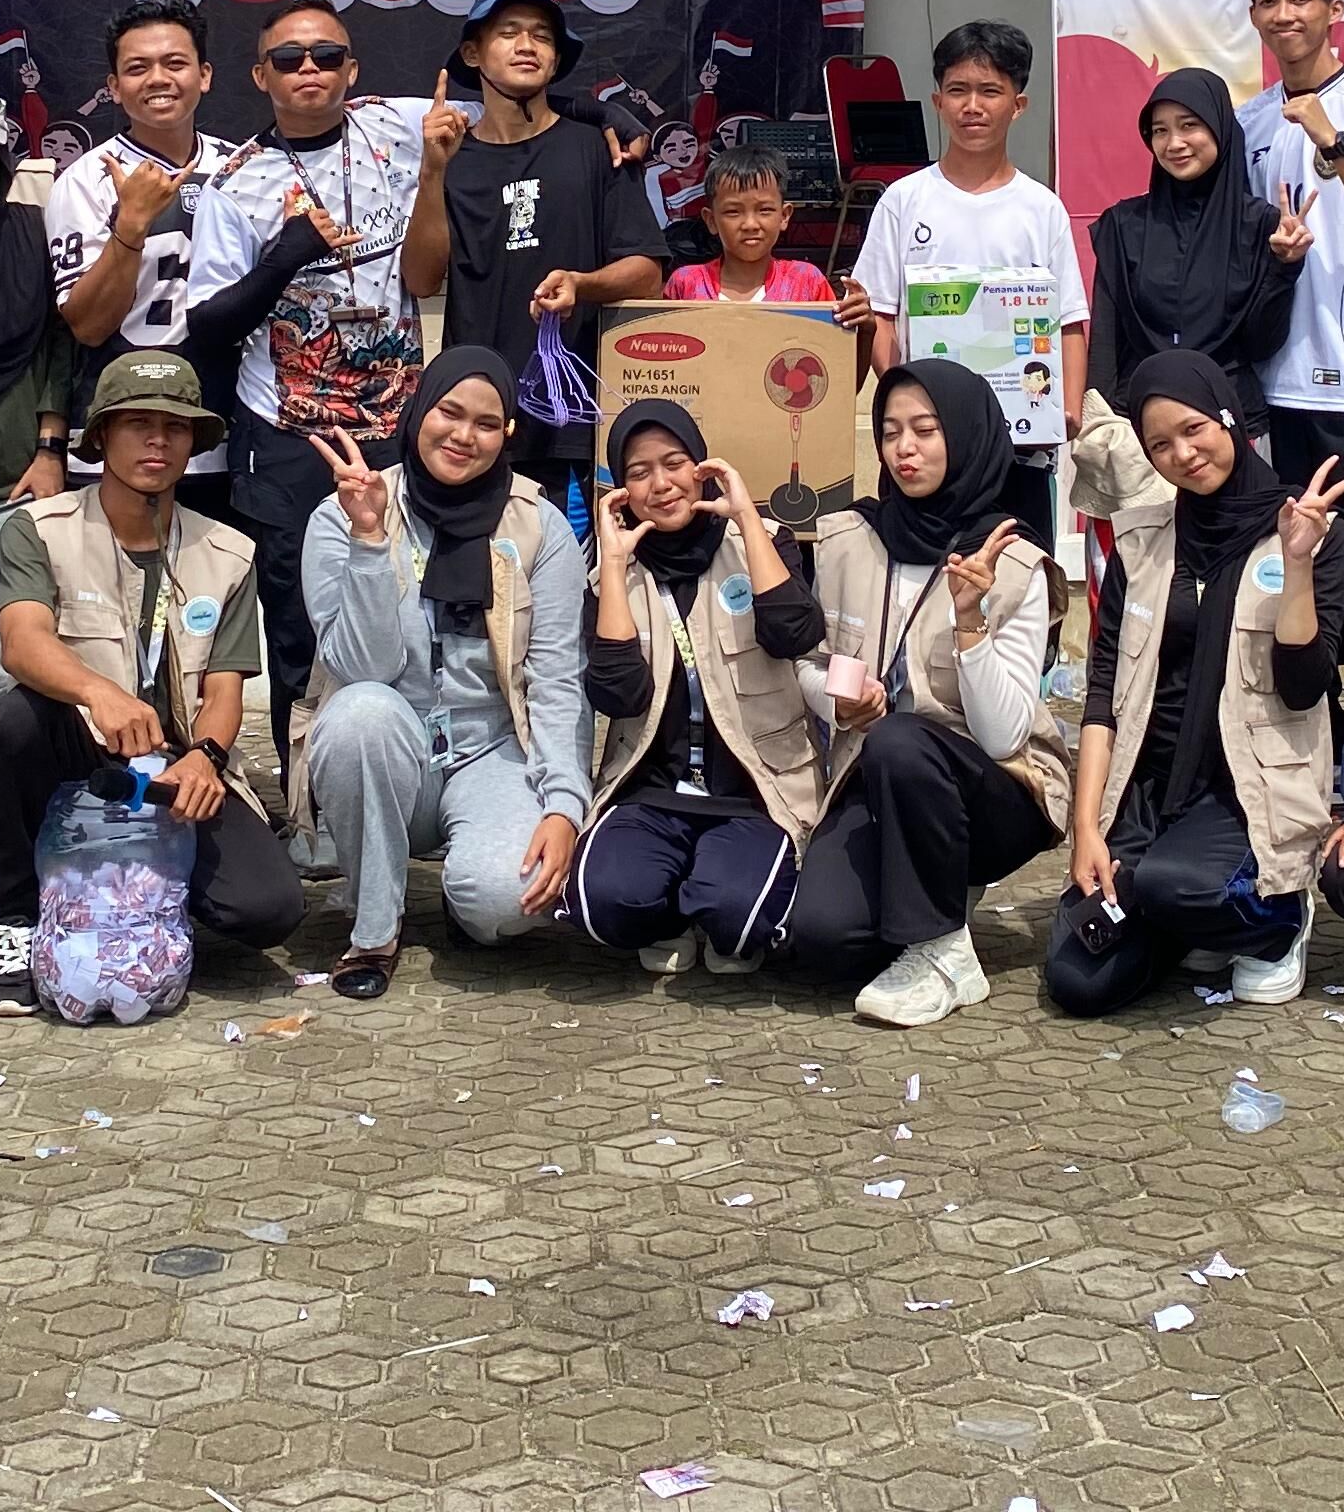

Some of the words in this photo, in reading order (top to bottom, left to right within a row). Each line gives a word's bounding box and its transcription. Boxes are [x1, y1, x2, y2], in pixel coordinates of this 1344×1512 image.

[999, 296, 1022, 307] 1.8
[1027, 295, 1049, 306] Ltr
[661, 340, 689, 354] viva
[622, 368, 675, 381] NV-1651
[622, 384, 659, 395] KIPAS
[660, 384, 701, 395] ANGIN
